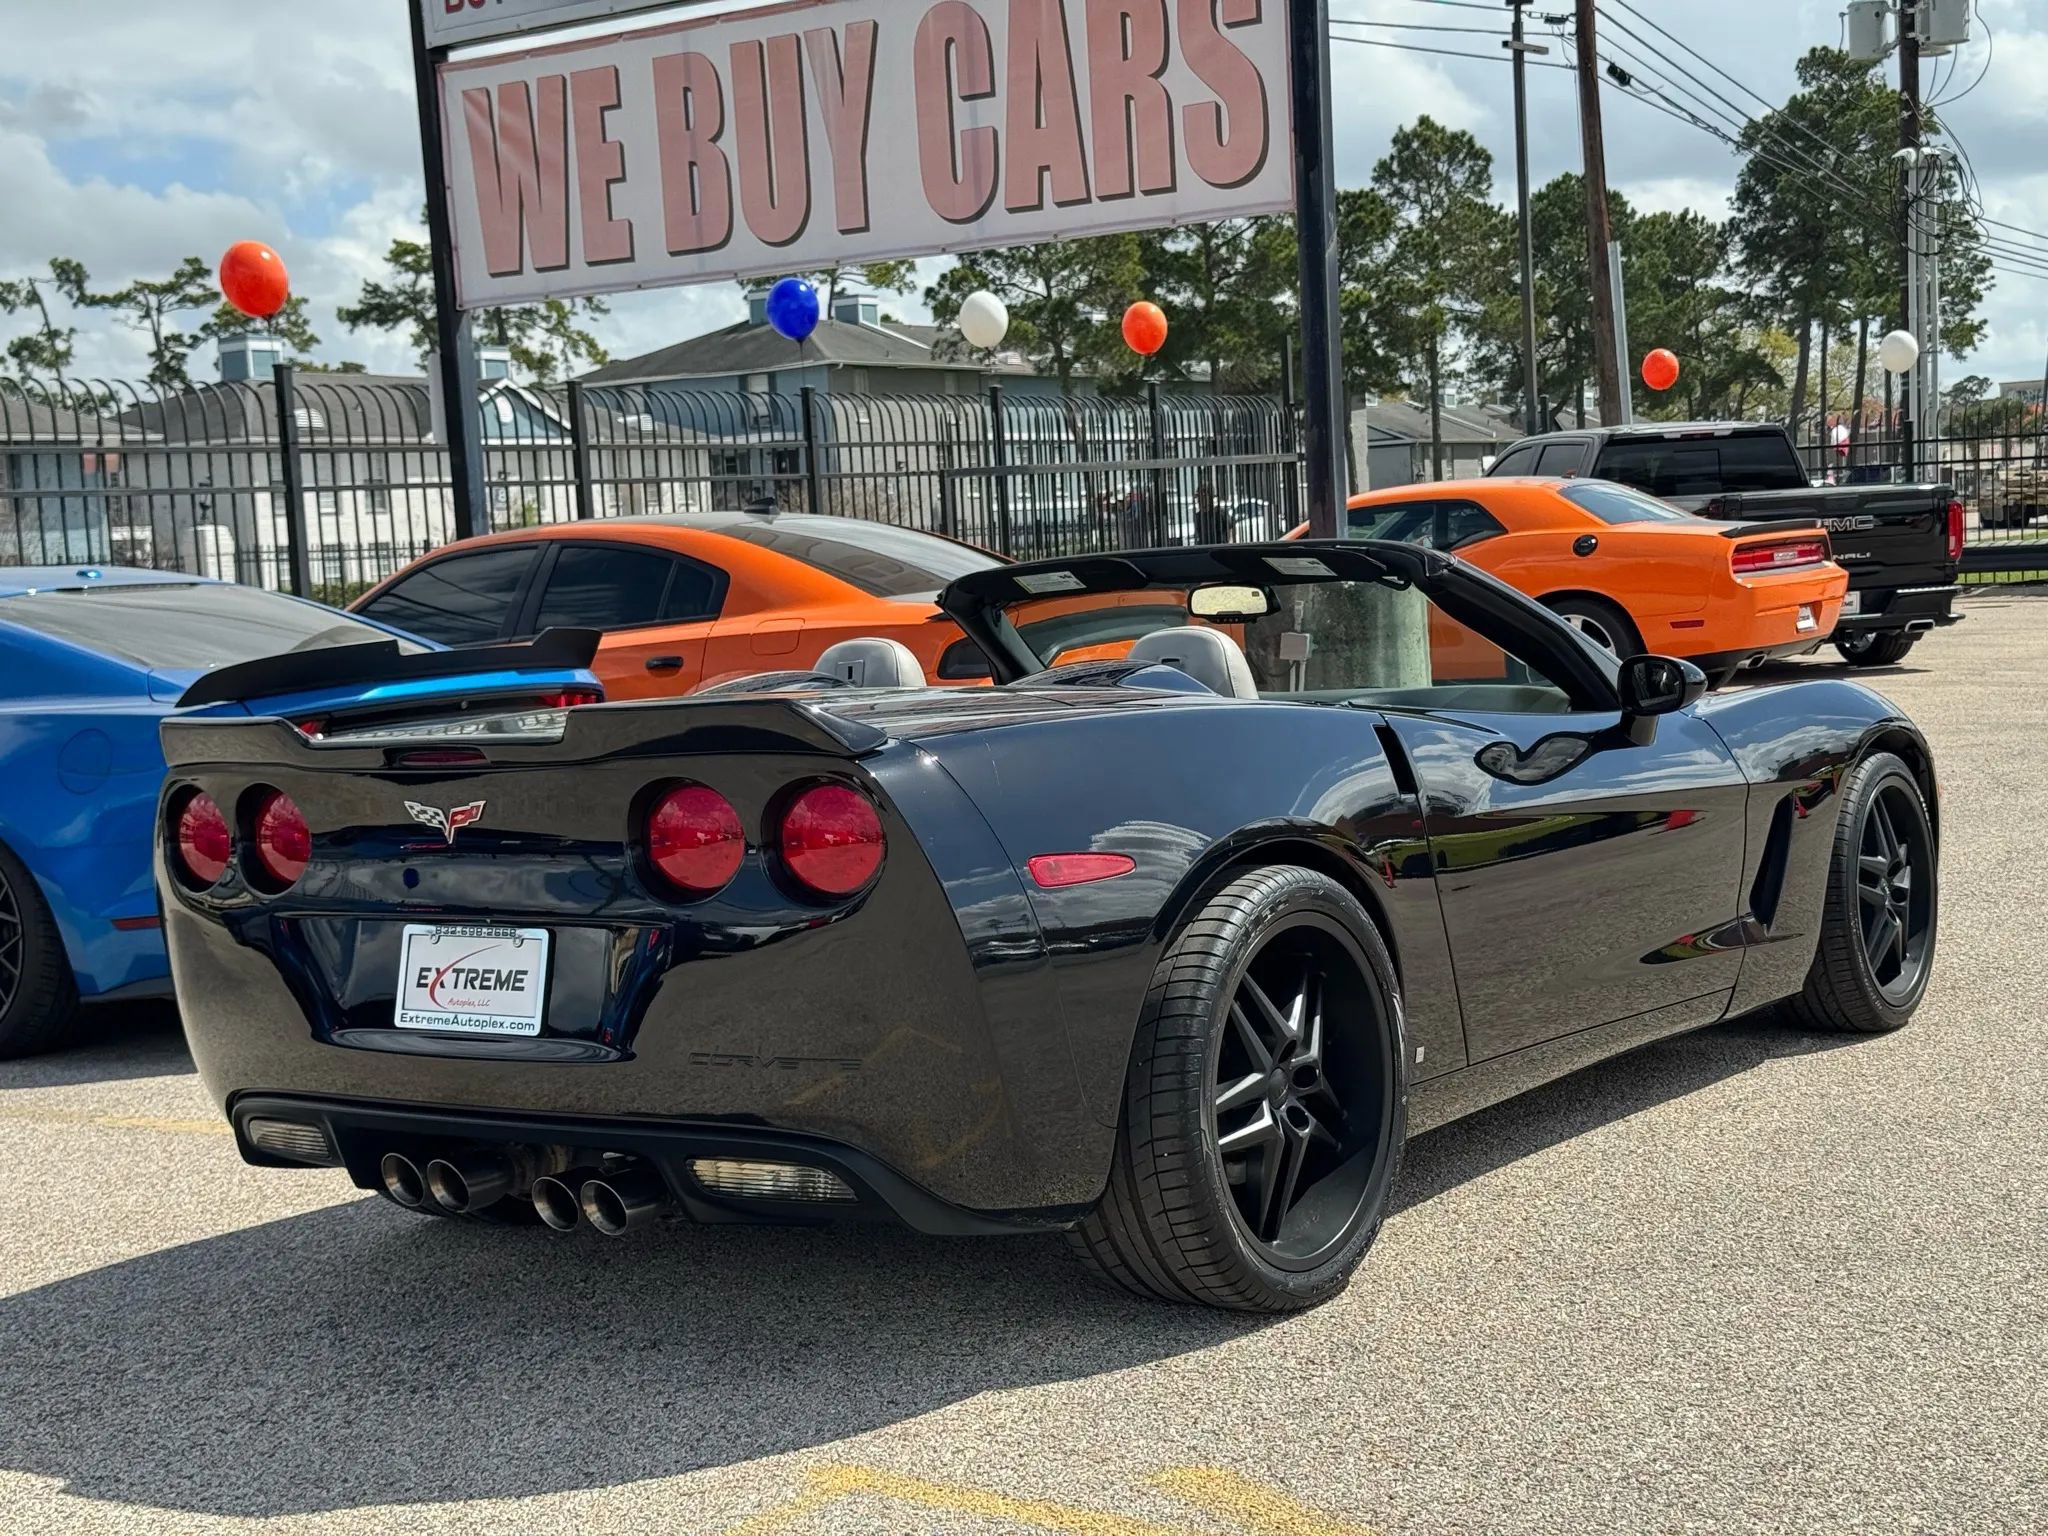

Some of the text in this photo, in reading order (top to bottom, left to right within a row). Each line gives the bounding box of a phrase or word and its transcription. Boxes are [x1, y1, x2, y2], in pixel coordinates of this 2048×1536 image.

[462, 0, 1270, 277] WE BUY CARS
[416, 967, 528, 991] EXTREME
[400, 1013, 535, 1030] ExtremeAutoplex.com
